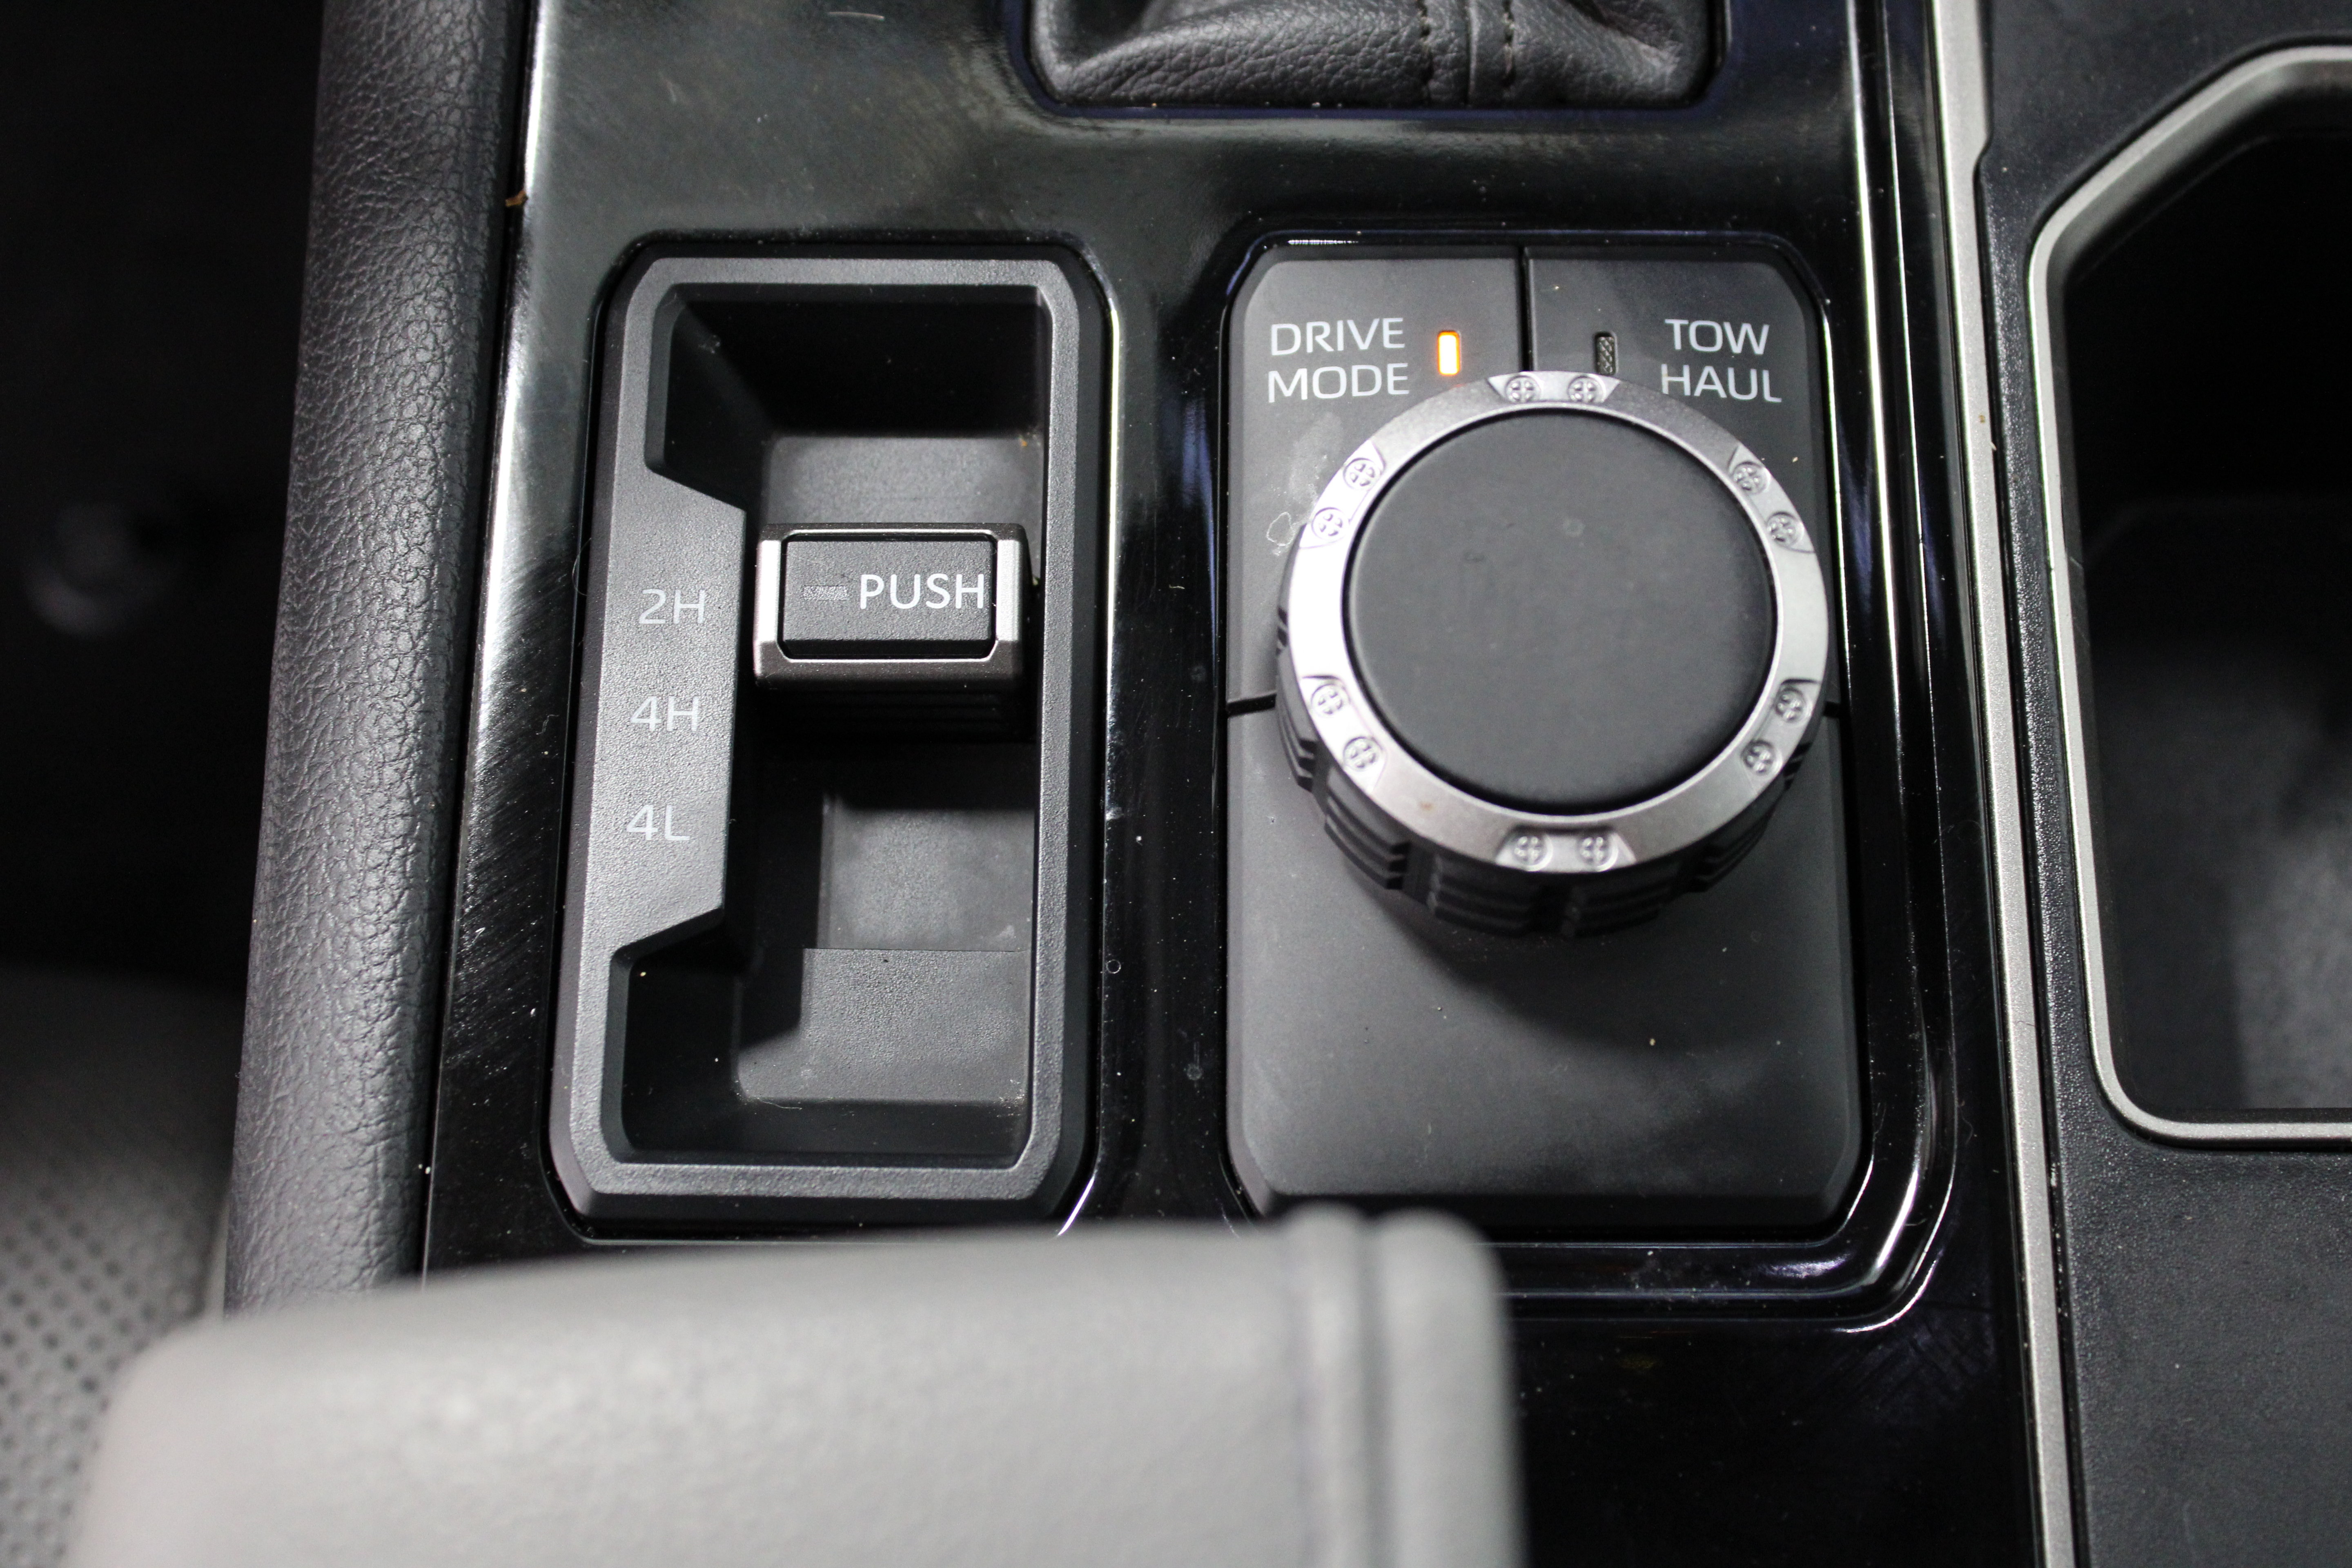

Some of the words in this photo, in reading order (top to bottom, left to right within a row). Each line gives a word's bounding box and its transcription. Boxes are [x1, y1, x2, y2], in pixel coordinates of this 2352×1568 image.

[1270, 318, 1405, 355] DRIVE
[1665, 319, 1769, 355] TOW
[1268, 363, 1409, 403] MODE
[1662, 364, 1782, 402] HAUL
[639, 589, 705, 624] 2H
[860, 573, 984, 609] PUSH
[630, 696, 699, 732] 4H
[626, 804, 690, 841] 4L
